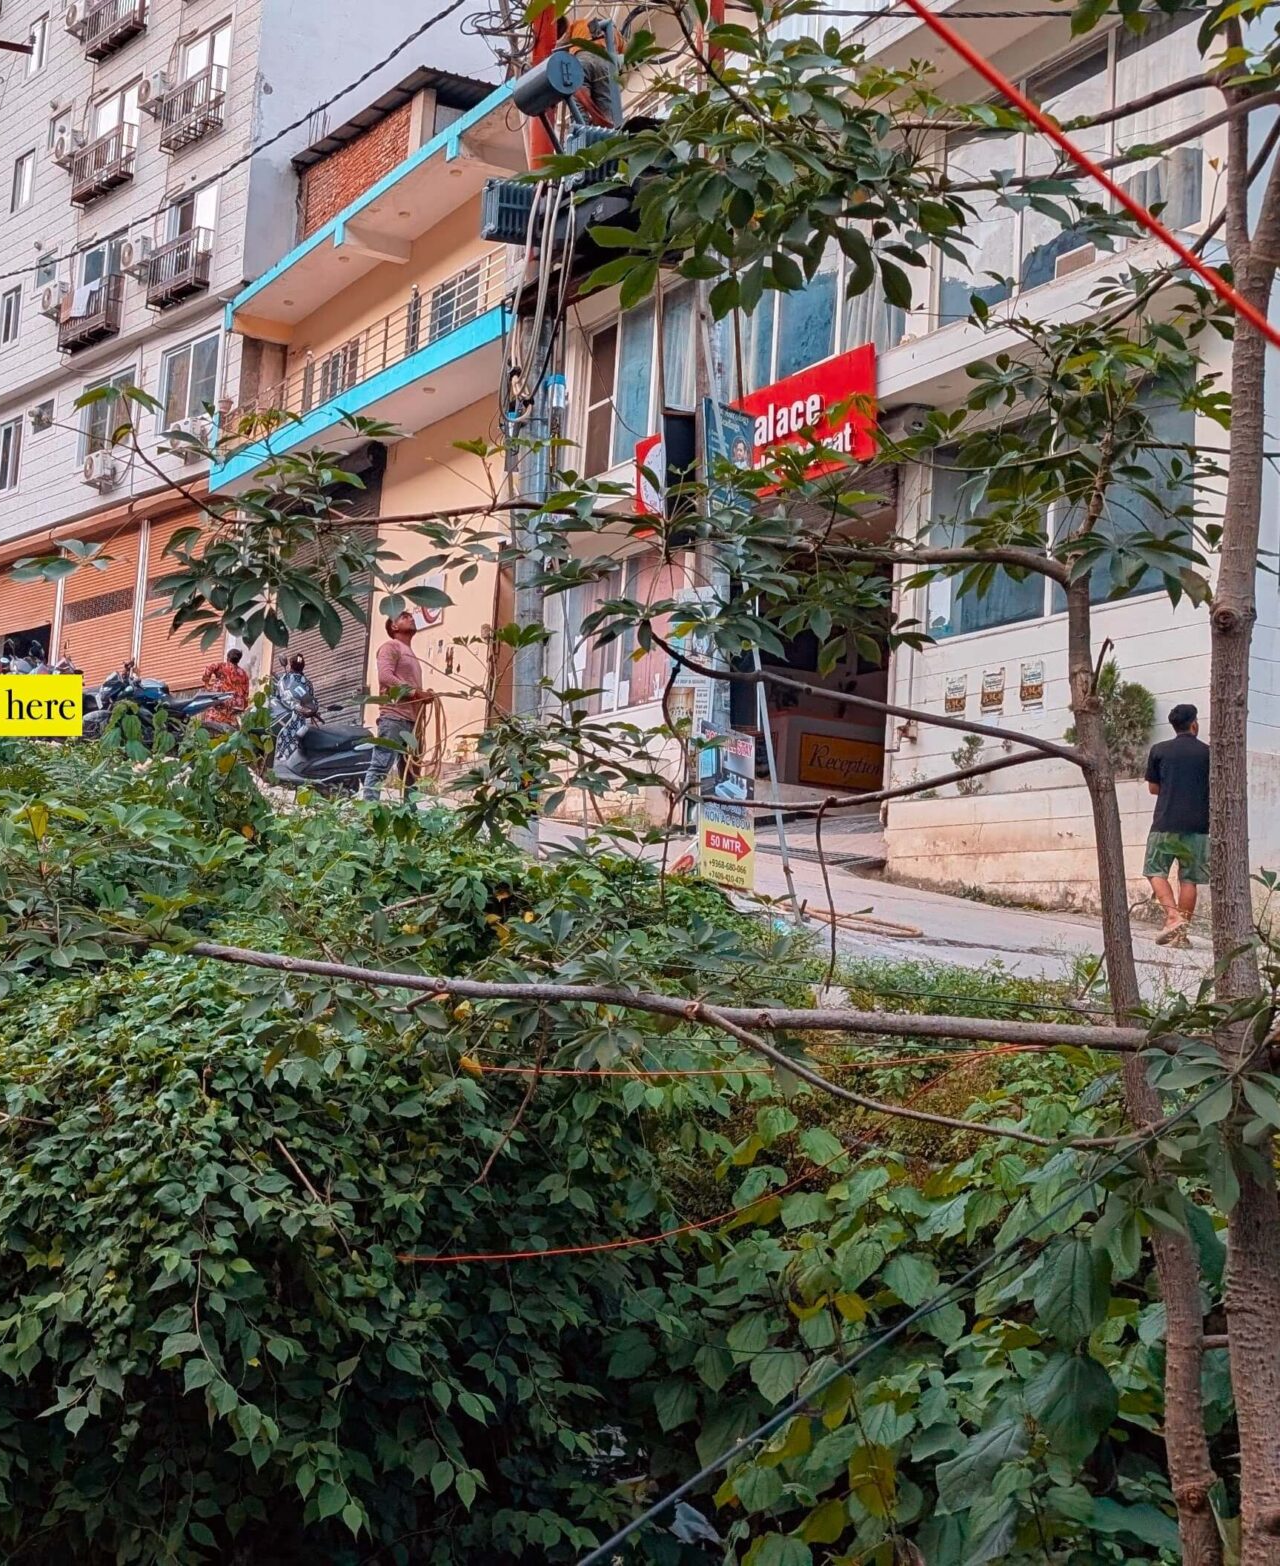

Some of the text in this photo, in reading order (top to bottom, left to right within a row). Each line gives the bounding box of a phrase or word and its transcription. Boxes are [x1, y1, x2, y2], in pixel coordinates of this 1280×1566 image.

[808, 743, 880, 777] Reception
[704, 807, 720, 823] NON
[731, 816, 751, 830] ROOM
[710, 834, 744, 853] 50 MTR.
